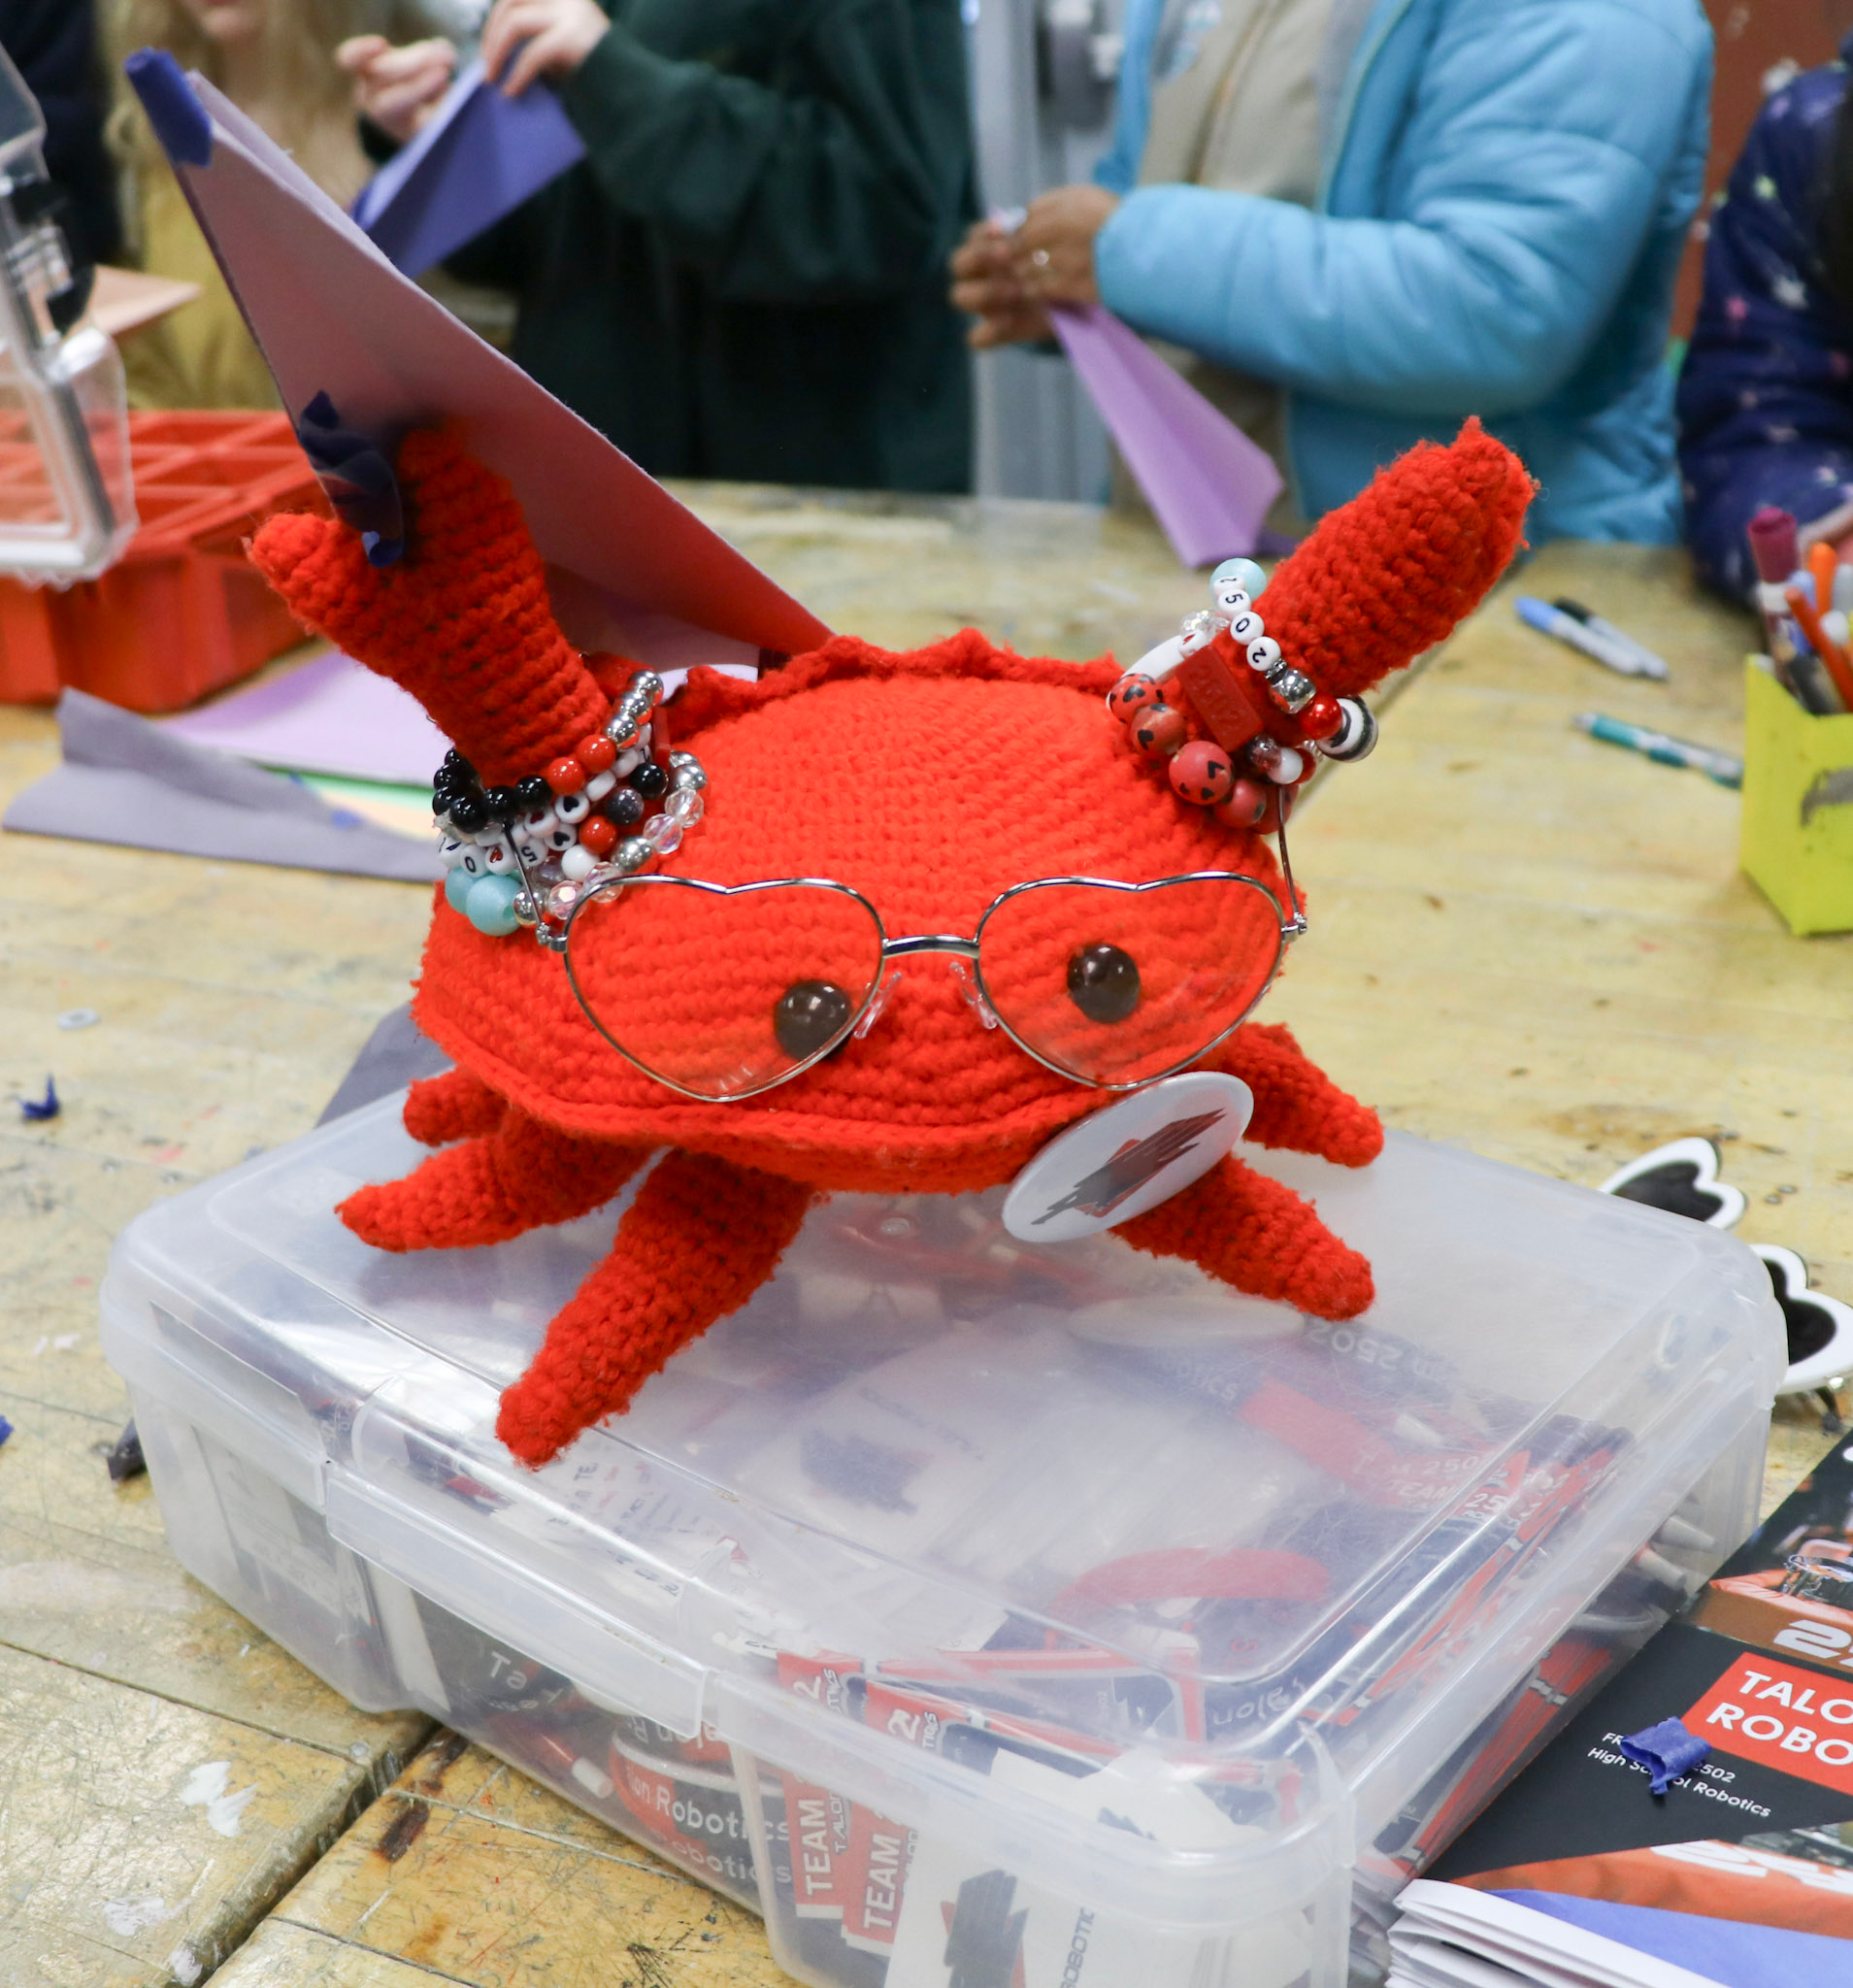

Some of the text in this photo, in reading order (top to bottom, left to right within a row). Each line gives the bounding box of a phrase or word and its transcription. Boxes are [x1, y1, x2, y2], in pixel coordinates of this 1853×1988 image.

[1587, 1746, 1627, 1767] High
[1693, 1781, 1771, 1818] Robotics
[797, 1798, 834, 1897] TEAM
[862, 1833, 902, 1930] TEAM
